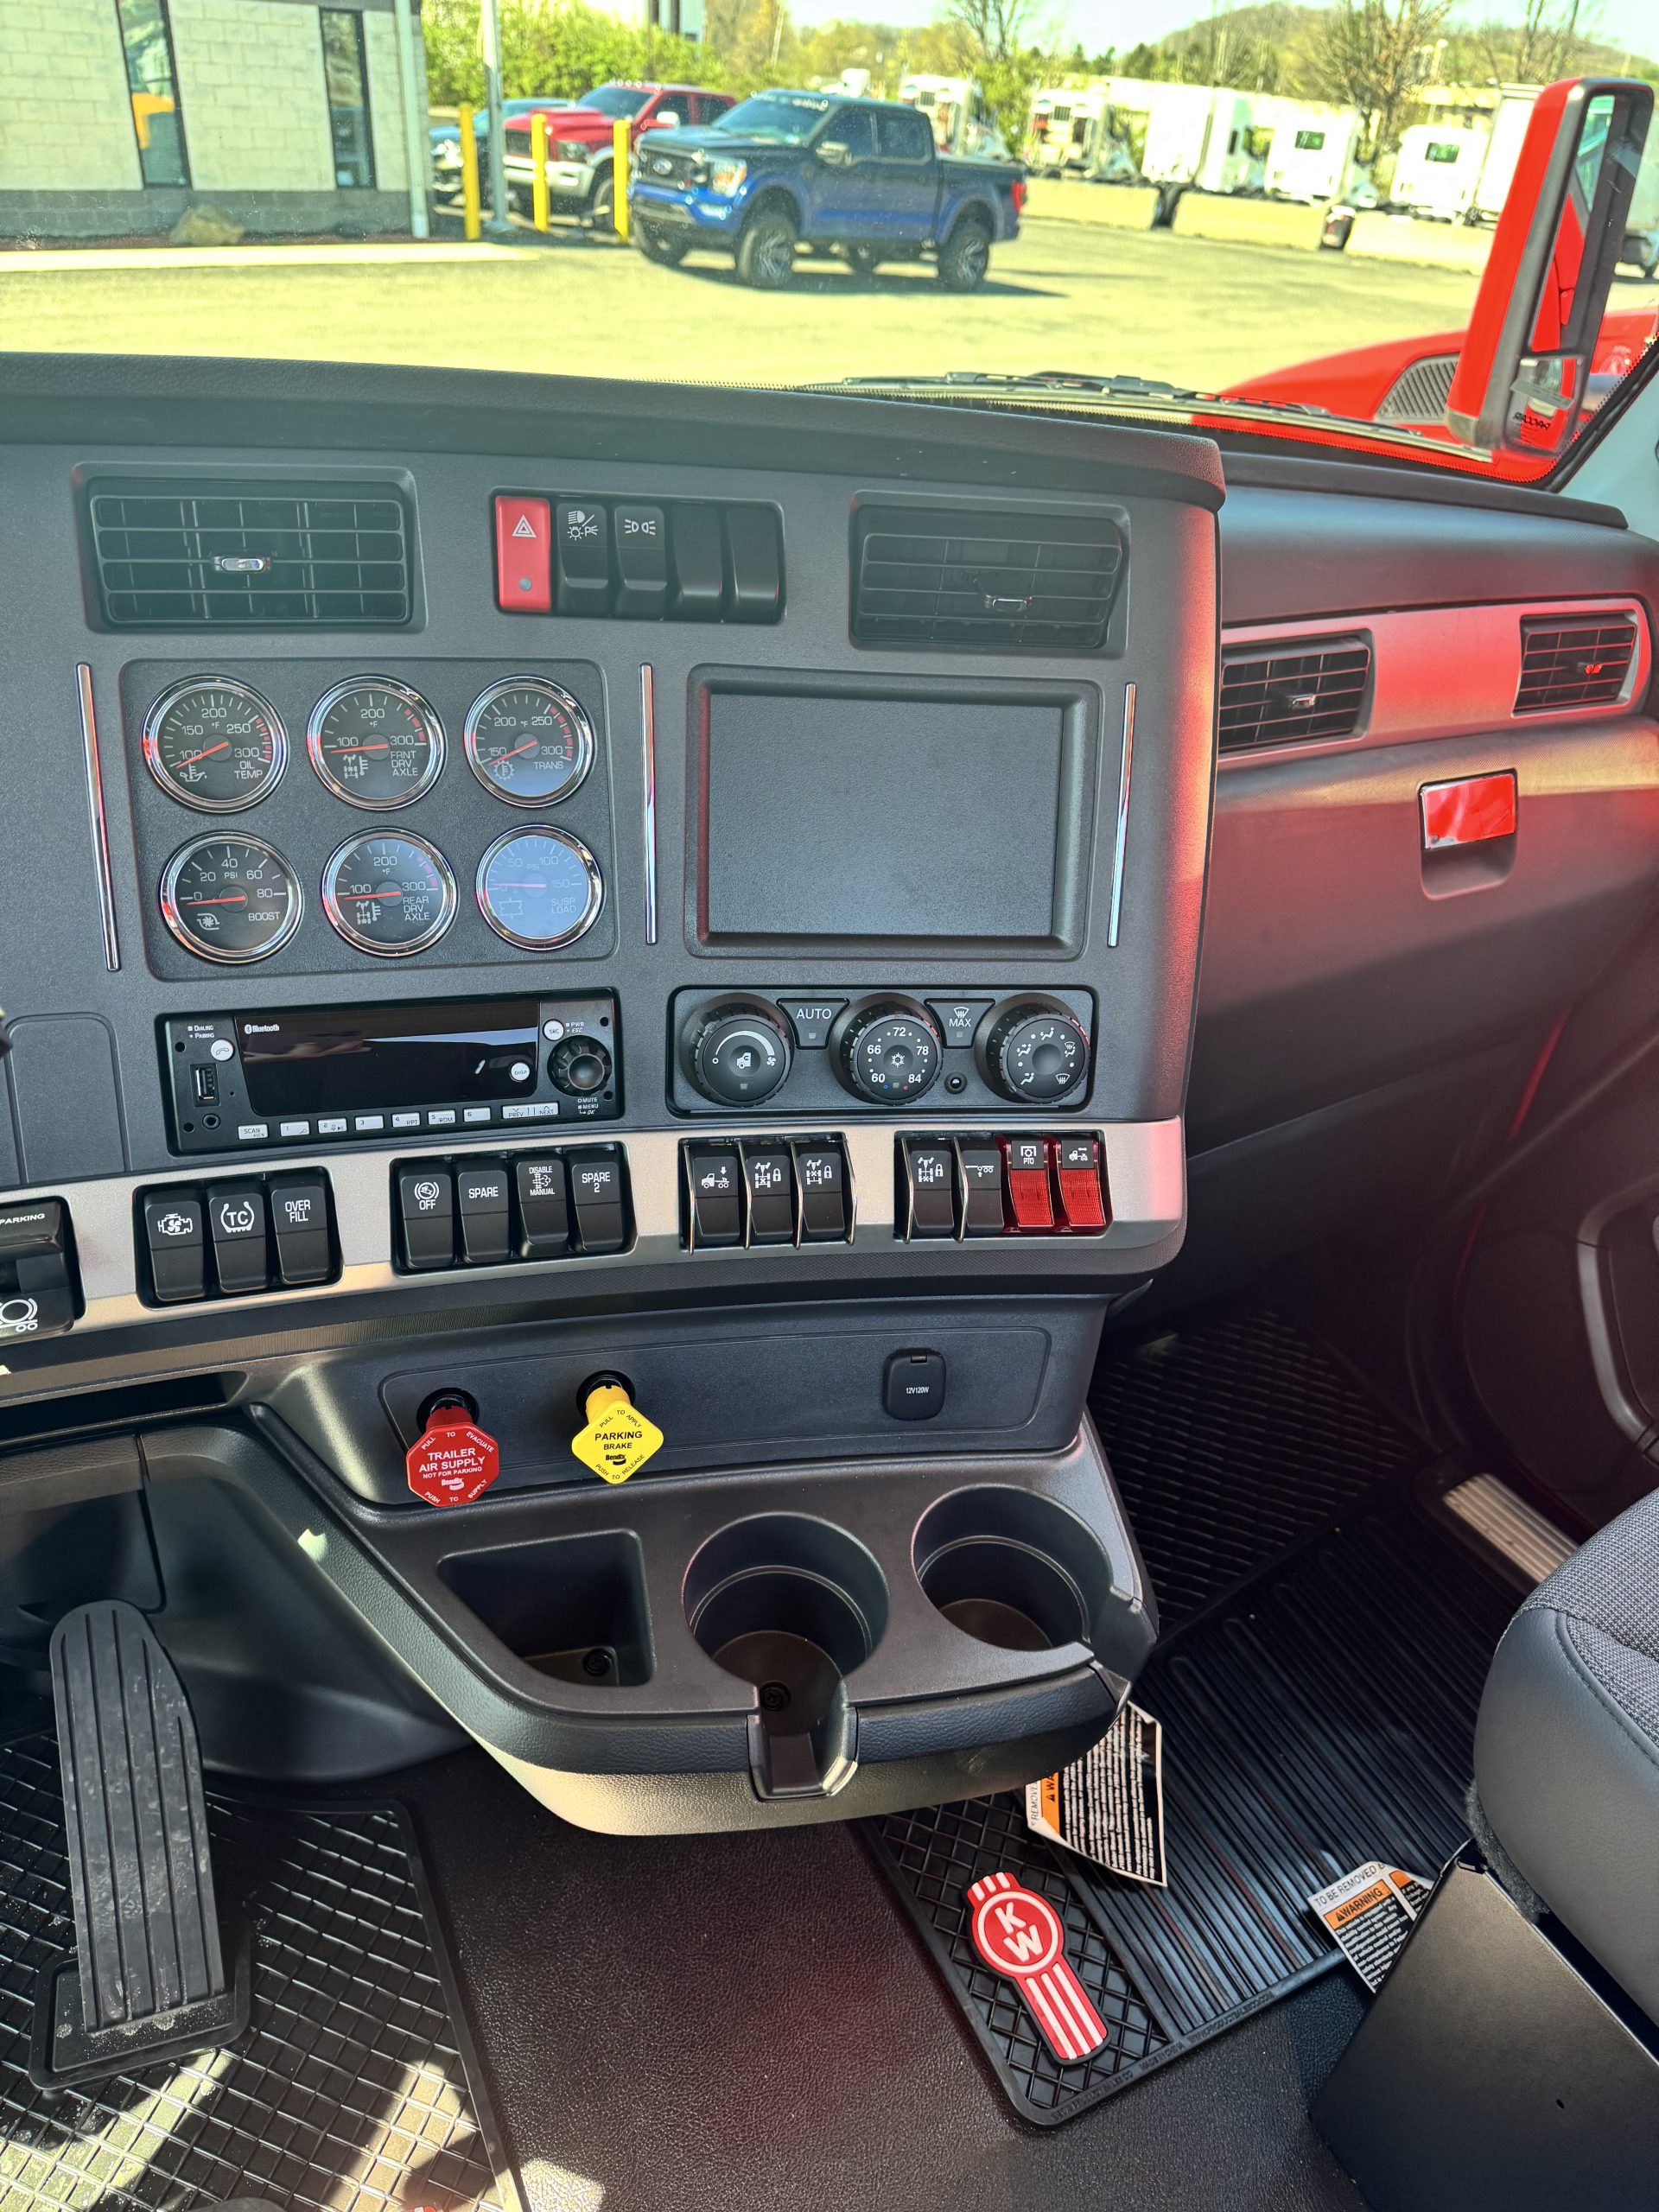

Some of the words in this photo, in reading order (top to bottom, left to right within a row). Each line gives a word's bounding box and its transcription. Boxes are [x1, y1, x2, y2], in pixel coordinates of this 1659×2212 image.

[201, 708, 226, 718] 200
[360, 709, 385, 719] 200
[494, 716, 517, 727] 200
[531, 716, 552, 726] 250
[181, 725, 204, 735] 150
[226, 723, 251, 734] 250
[337, 736, 359, 747] 100
[390, 735, 414, 746] 300
[179, 750, 202, 760] 100
[234, 747, 259, 758] 300
[391, 750, 416, 760] FRNT
[488, 747, 507, 757] 150
[541, 746, 563, 756] 300
[239, 760, 255, 770] OIL
[391, 760, 412, 768] DRV
[533, 761, 564, 770] TRANS
[234, 770, 263, 779] TEMP
[392, 767, 418, 777] AXLE
[221, 858, 238, 868] 40
[373, 856, 397, 867] 200
[508, 858, 523, 868] 50
[538, 856, 559, 866] 100
[200, 872, 216, 882] 20
[246, 869, 263, 880] 60
[402, 881, 426, 892] 300
[551, 879, 570, 888] 150
[257, 888, 273, 899] 80
[350, 884, 372, 894] 100
[194, 892, 202, 901] 0
[403, 896, 429, 905] REAR
[550, 897, 575, 906] SUSP
[404, 905, 423, 913] DRV
[551, 906, 576, 914] LOAD
[248, 912, 280, 922] BOOST
[404, 912, 430, 921] AXLE
[796, 1008, 832, 1020] AUTO
[949, 1018, 971, 1027] MAX
[252, 1024, 280, 1033] Bluetooth
[893, 1027, 906, 1037] 72
[867, 1045, 881, 1055] 66
[916, 1046, 929, 1056] 78
[871, 1073, 886, 1084] 60
[908, 1073, 922, 1084] 84
[529, 1166, 552, 1174] DISABLE
[582, 1172, 611, 1183] SPARE
[468, 1185, 499, 1199] SPARE
[530, 1188, 556, 1197] MANUAL
[594, 1183, 601, 1193] 2
[284, 1199, 311, 1212] OVER
[419, 1199, 435, 1211] OFF
[0, 1213, 45, 1225] PARKING
[226, 1211, 249, 1226] TC
[289, 1211, 308, 1224] FILL
[599, 1416, 613, 1428] PULL
[626, 1414, 642, 1428] APPLY
[594, 1431, 643, 1441] PARKING
[421, 1436, 436, 1450] PULL
[466, 1431, 495, 1453] EVACUATE
[603, 1442, 632, 1451] BRAKE
[427, 1447, 476, 1461] TRAILER
[419, 1463, 438, 1473] AIR
[441, 1456, 486, 1470] SUPPLY
[594, 1464, 610, 1477] PUSH
[621, 1453, 645, 1475] RELEASE
[453, 1466, 482, 1475] PARKING
[424, 1491, 441, 1504] PUSH
[467, 1479, 487, 1499] SUPPLY
[1314, 1895, 1327, 1906] TO
[1327, 1888, 1339, 1901] BE
[1338, 1865, 1377, 1895] REMOVED
[1343, 1887, 1382, 1919] WARNING
